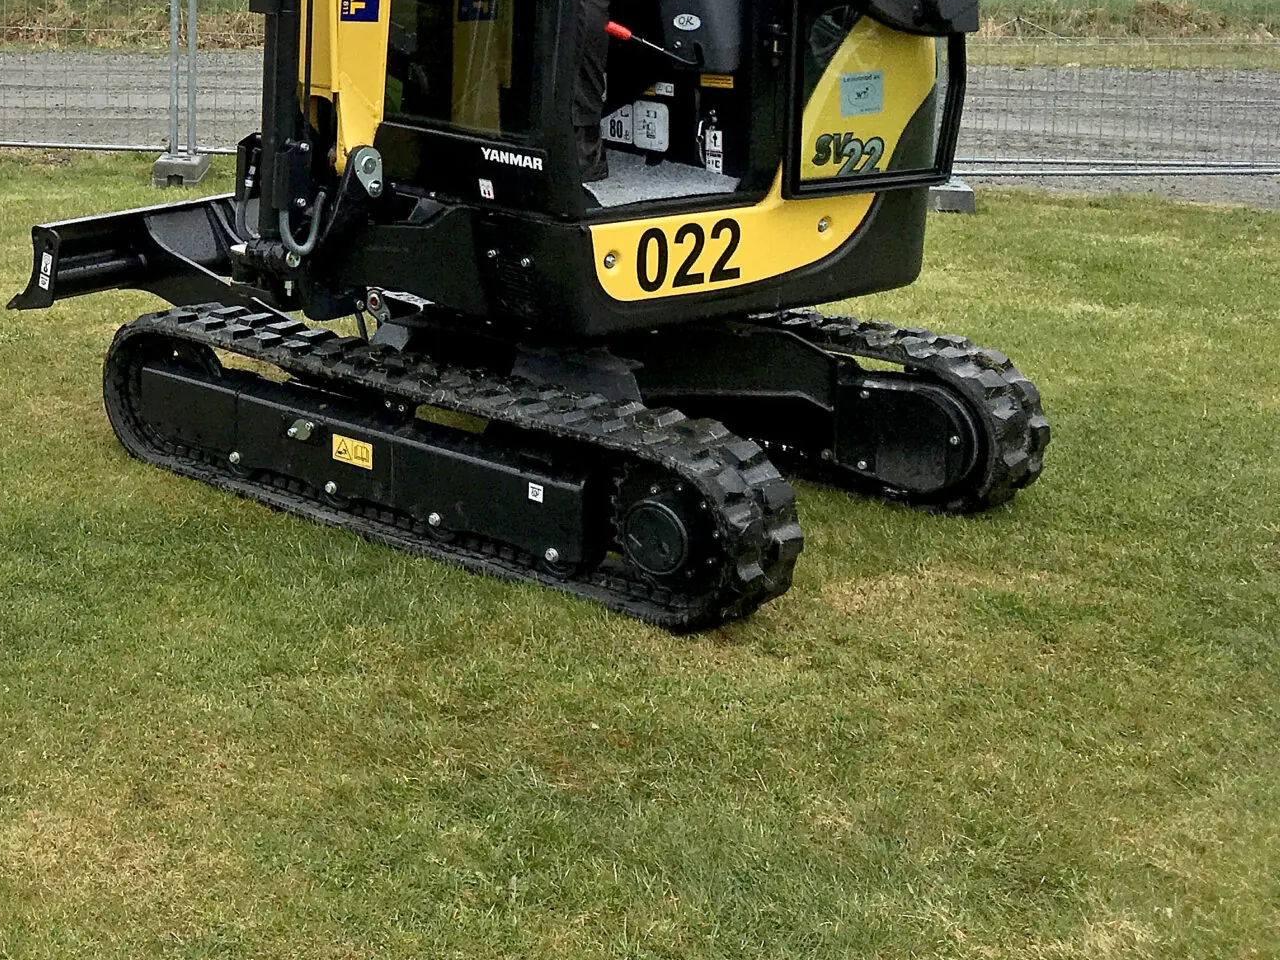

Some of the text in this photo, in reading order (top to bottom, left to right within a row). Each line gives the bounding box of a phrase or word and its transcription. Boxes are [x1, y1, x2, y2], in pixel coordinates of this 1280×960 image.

[609, 118, 623, 138] 80
[480, 146, 543, 171] YANMAR
[636, 218, 741, 292] 022
